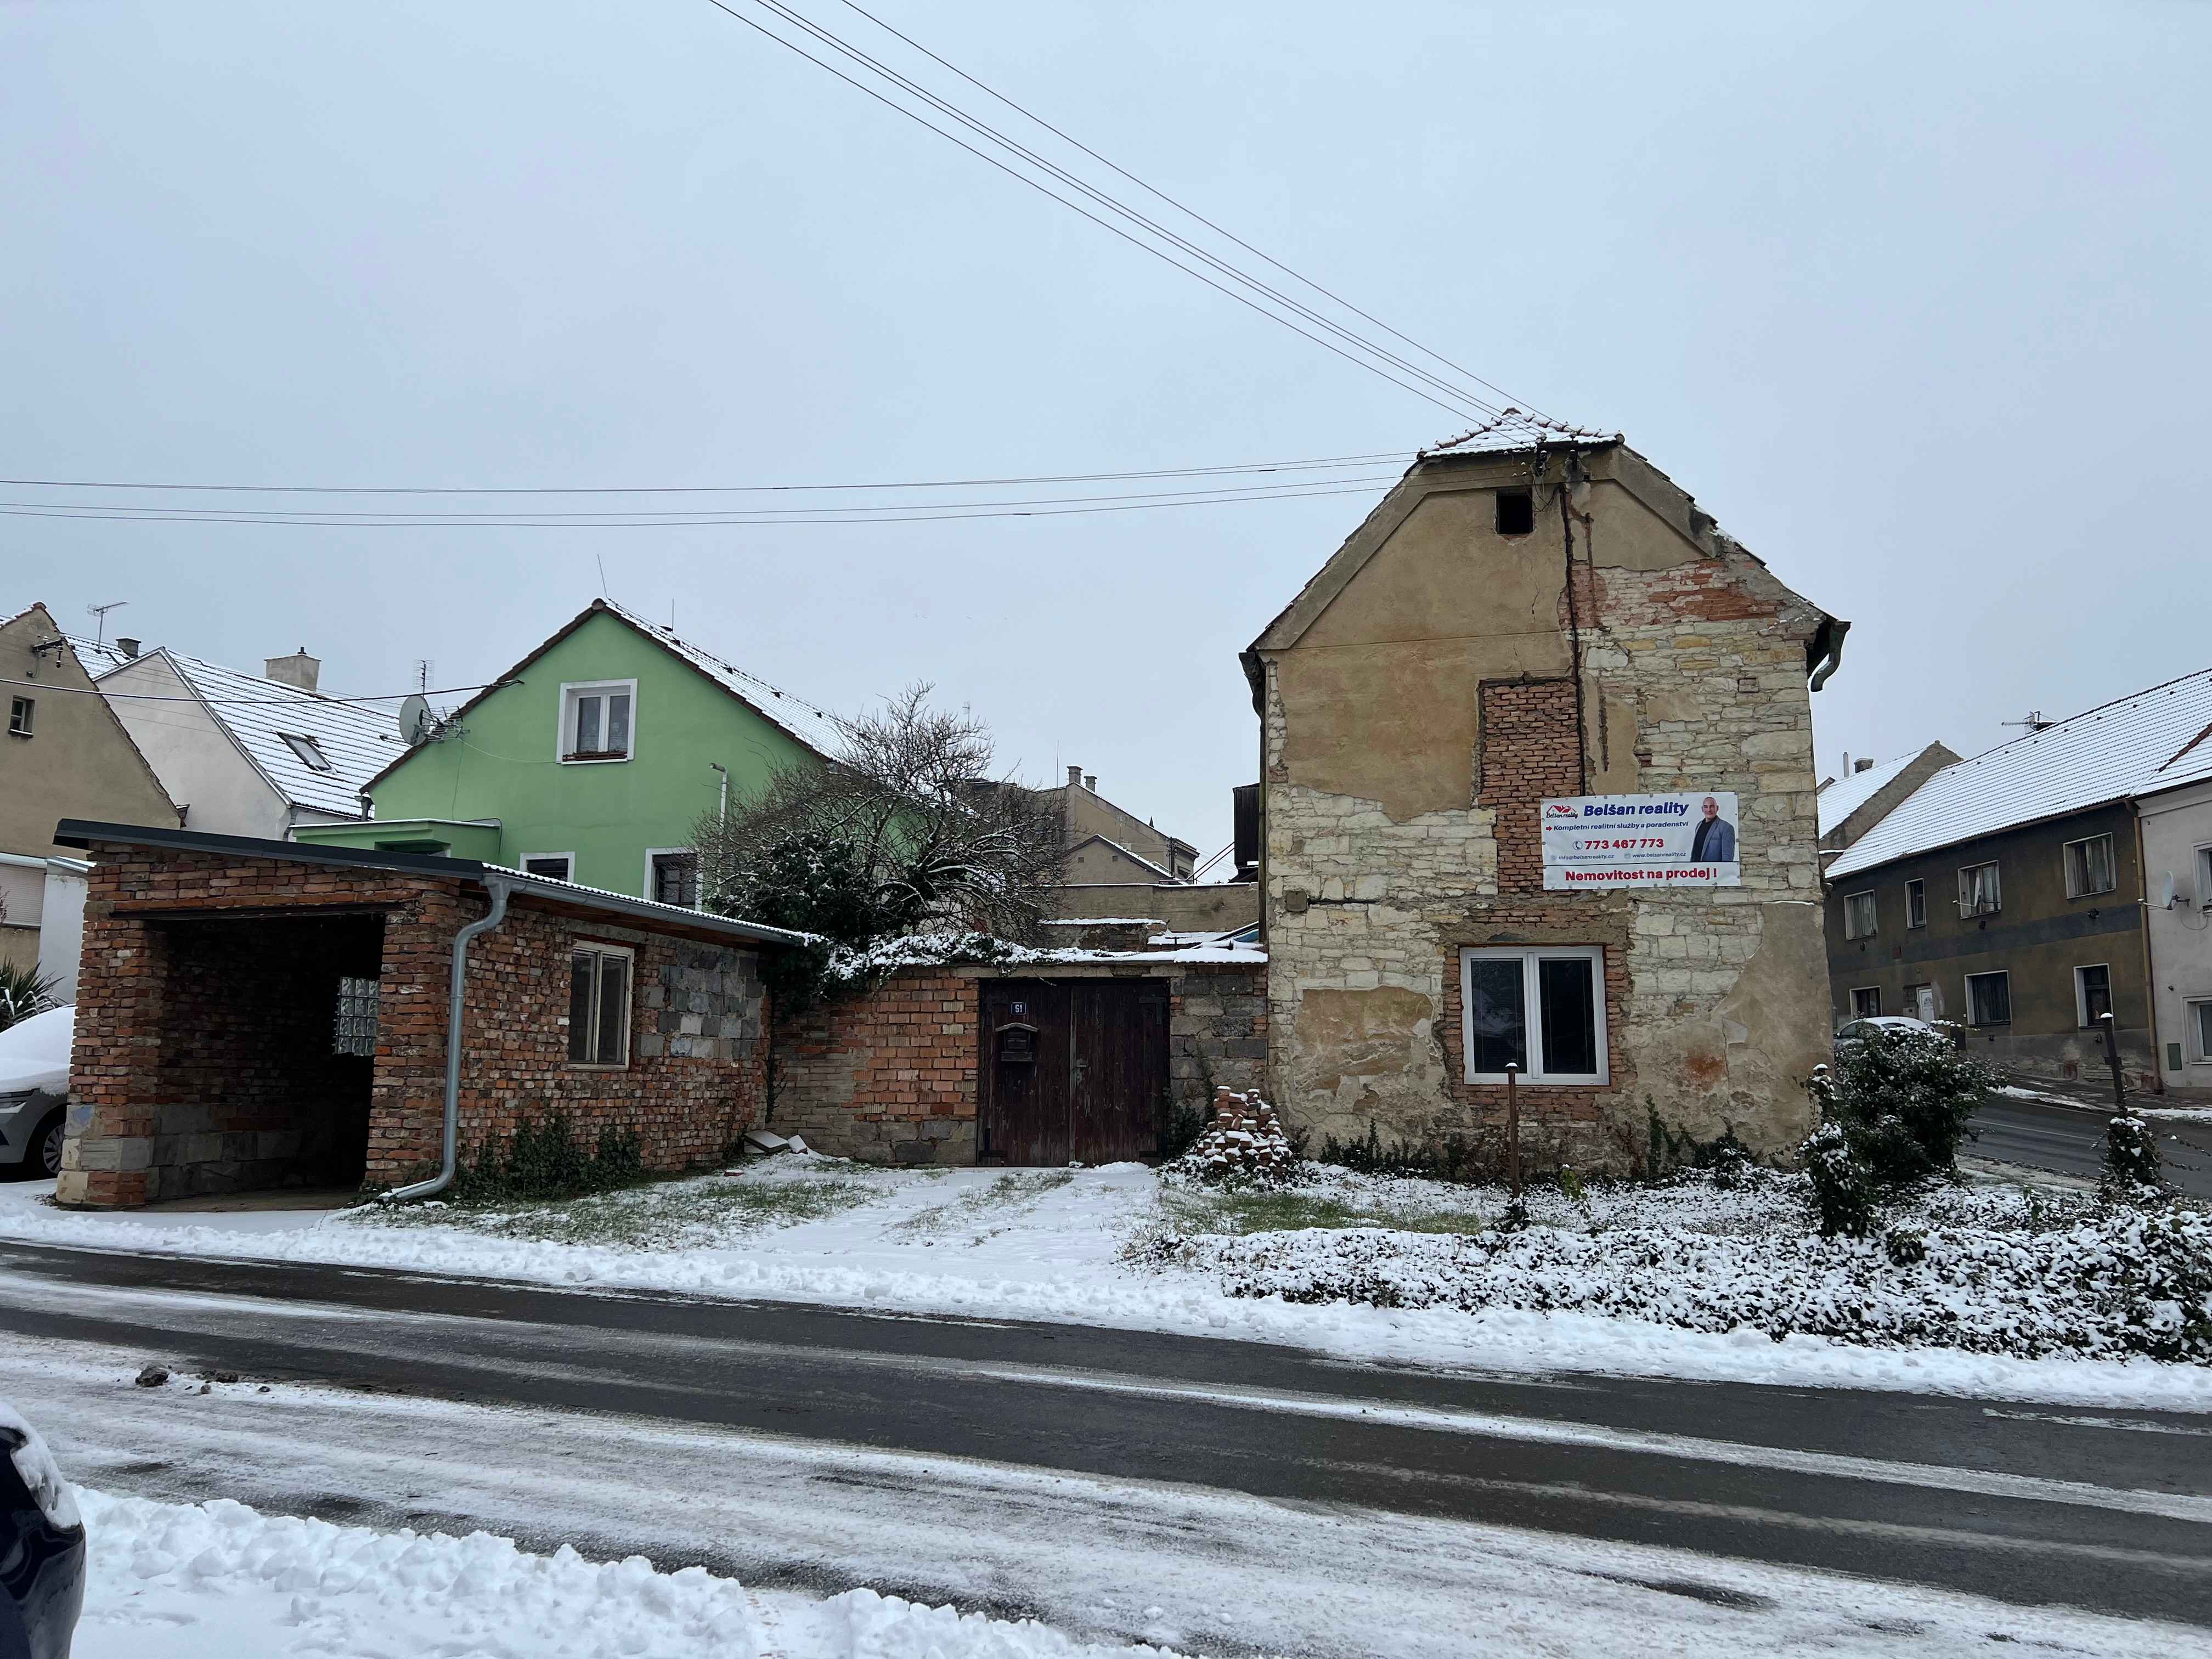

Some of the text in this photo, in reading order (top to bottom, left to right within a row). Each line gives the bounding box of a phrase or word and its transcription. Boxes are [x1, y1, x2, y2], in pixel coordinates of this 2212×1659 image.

[1584, 802, 1689, 816] Belšan reality
[1584, 838, 1664, 850] 773 467 773
[1566, 869, 1644, 881] Nemovitost
[1666, 867, 1710, 881] prodej
[1713, 868, 1717, 878] !
